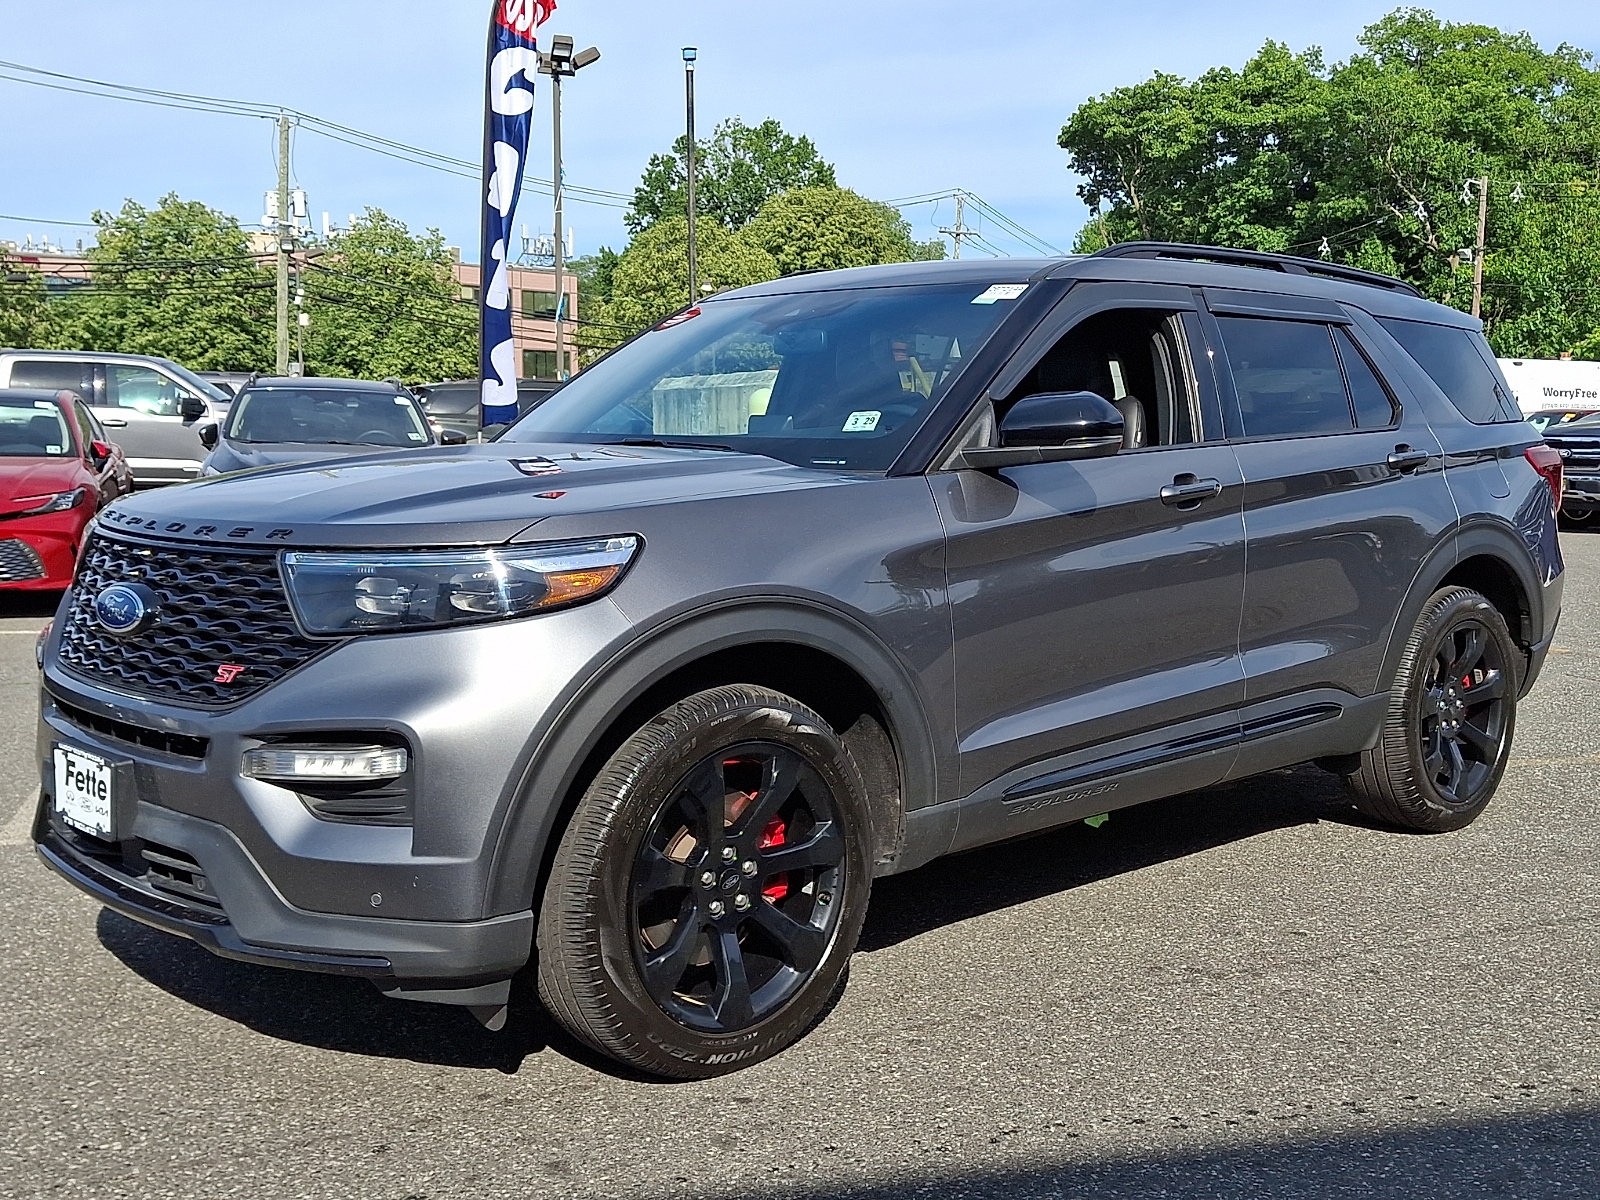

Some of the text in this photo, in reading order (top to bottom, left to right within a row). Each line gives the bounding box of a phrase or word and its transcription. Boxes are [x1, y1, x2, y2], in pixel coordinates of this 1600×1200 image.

[1542, 386, 1598, 400] WorryFree
[851, 417, 859, 426] 3
[103, 510, 294, 540] EXPLORER
[213, 664, 244, 683] ST
[65, 759, 107, 801] Fette
[1008, 783, 1119, 816] EXPLORER
